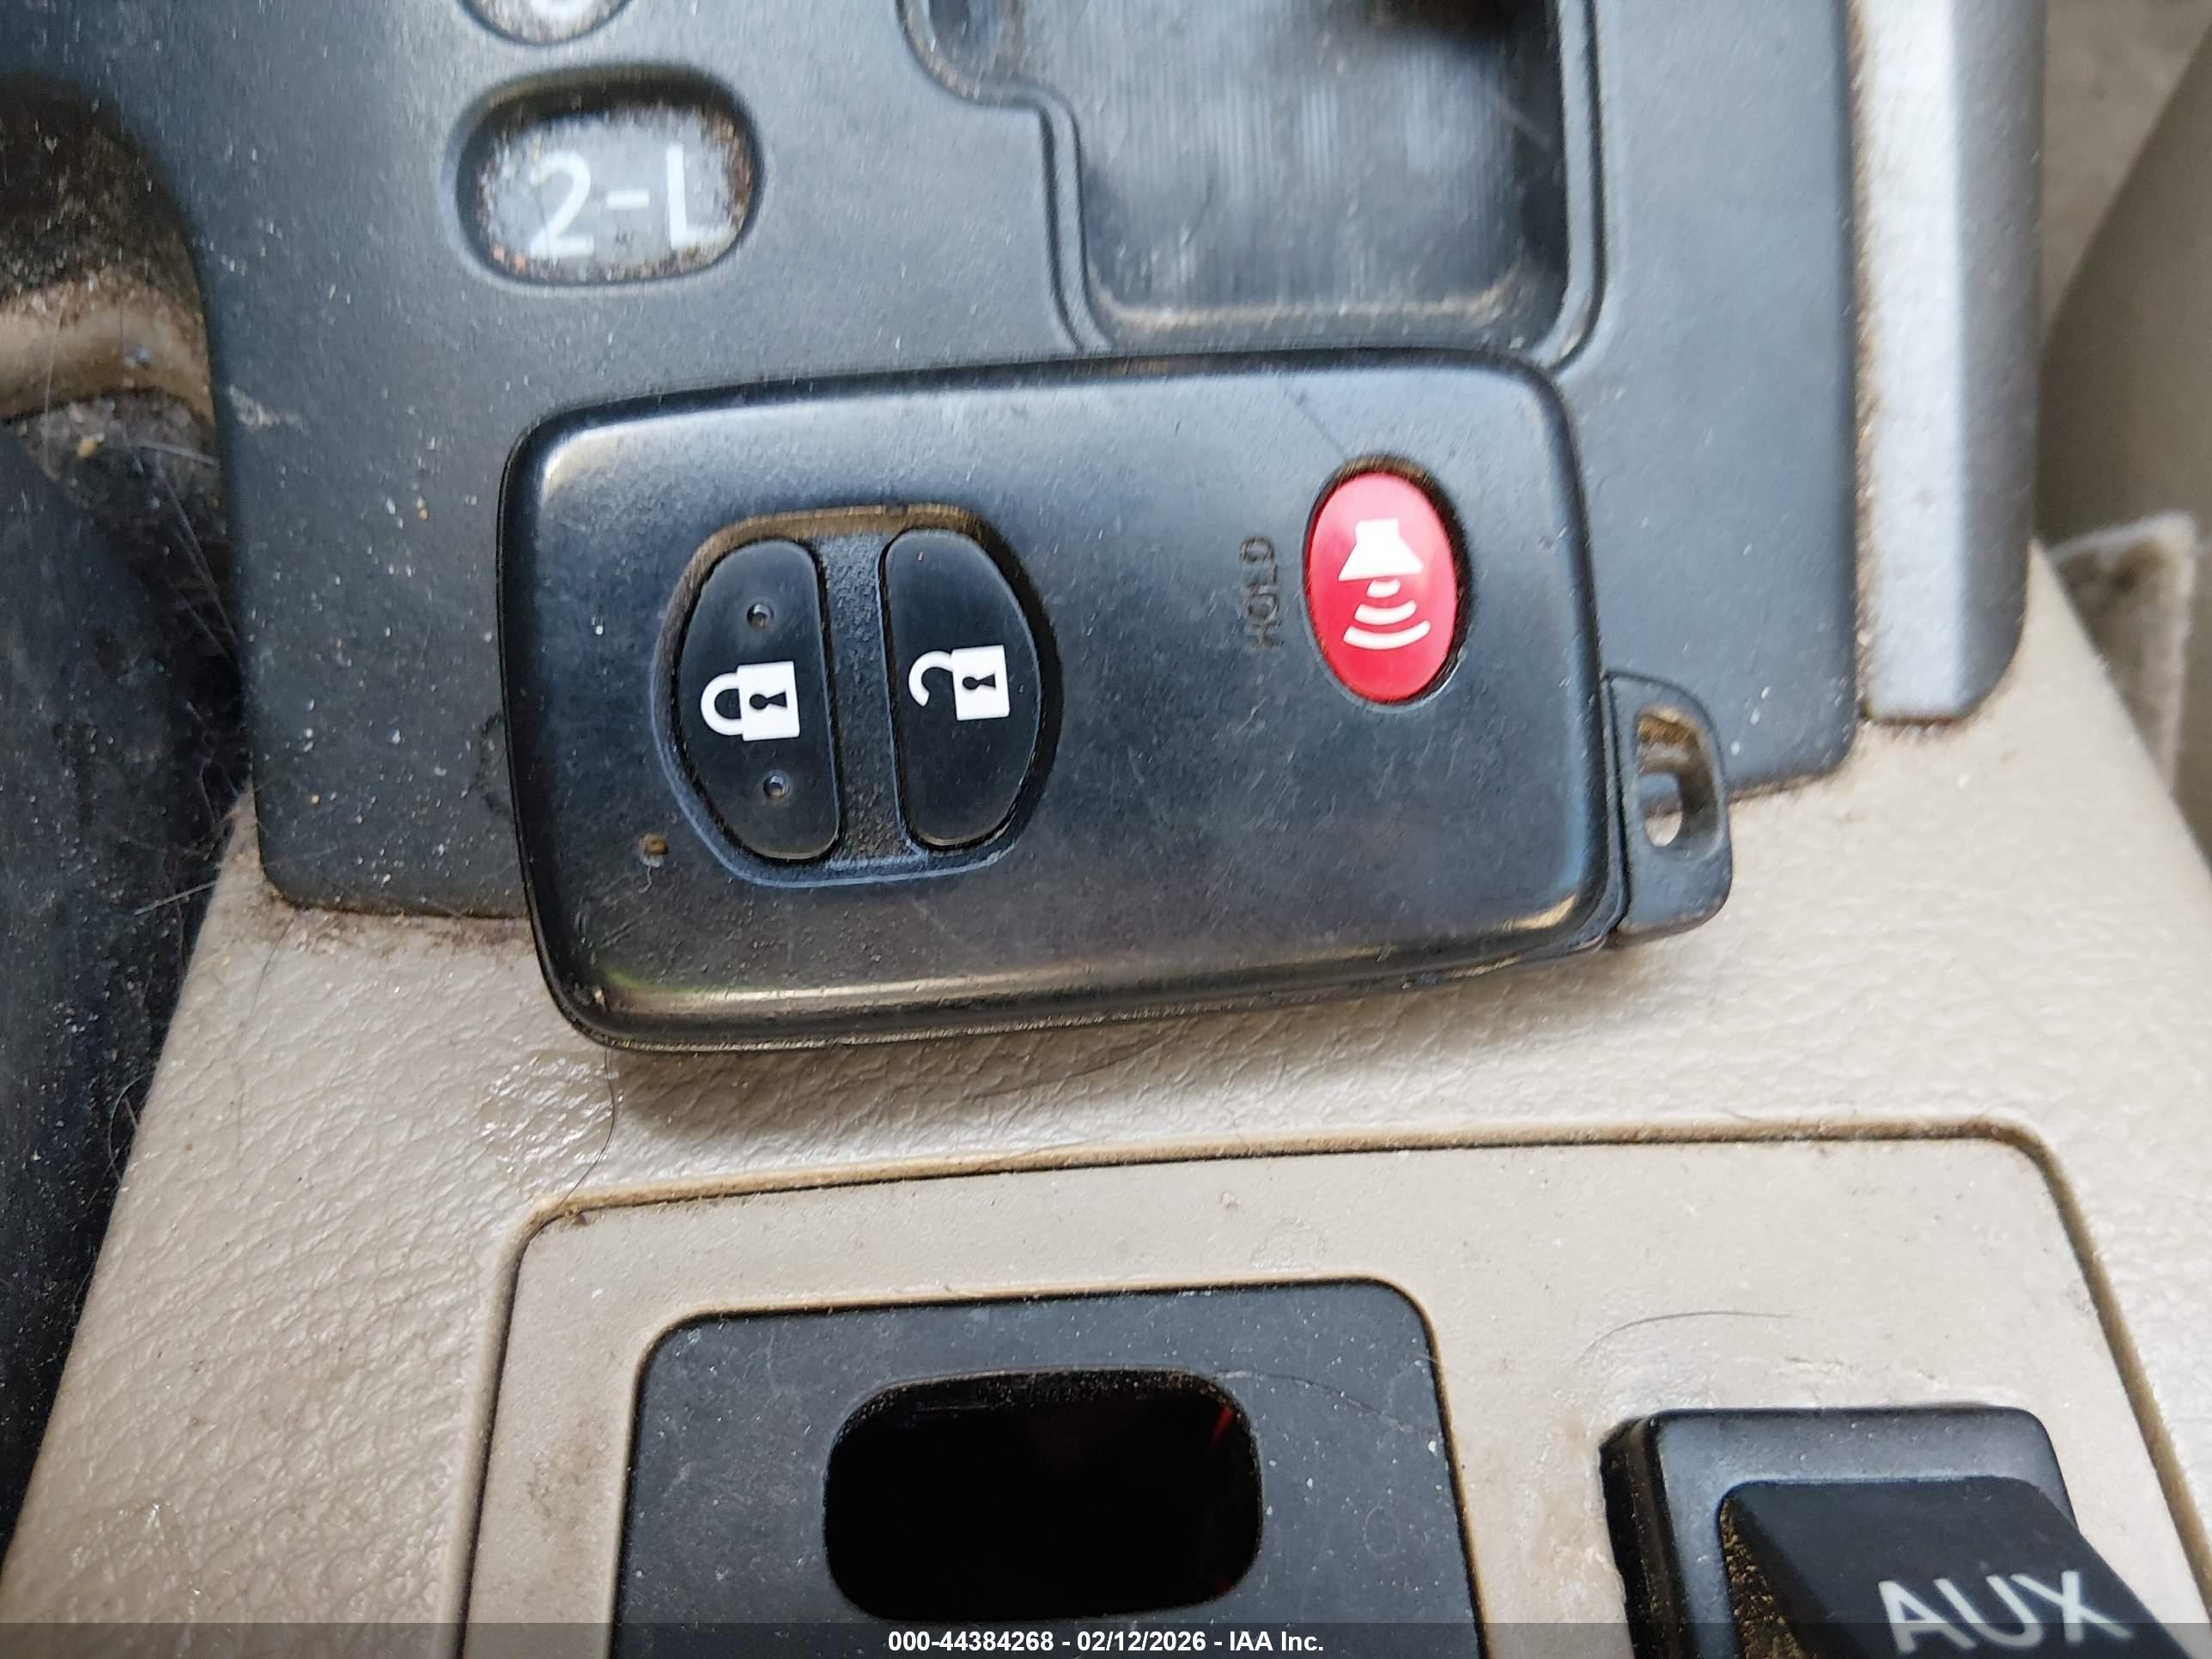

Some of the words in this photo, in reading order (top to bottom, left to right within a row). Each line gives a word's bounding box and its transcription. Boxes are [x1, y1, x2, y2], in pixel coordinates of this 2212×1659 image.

[529, 143, 734, 258] 2-L
[1238, 535, 1284, 648] HOLD
[1877, 1570, 2134, 1654] AUX
